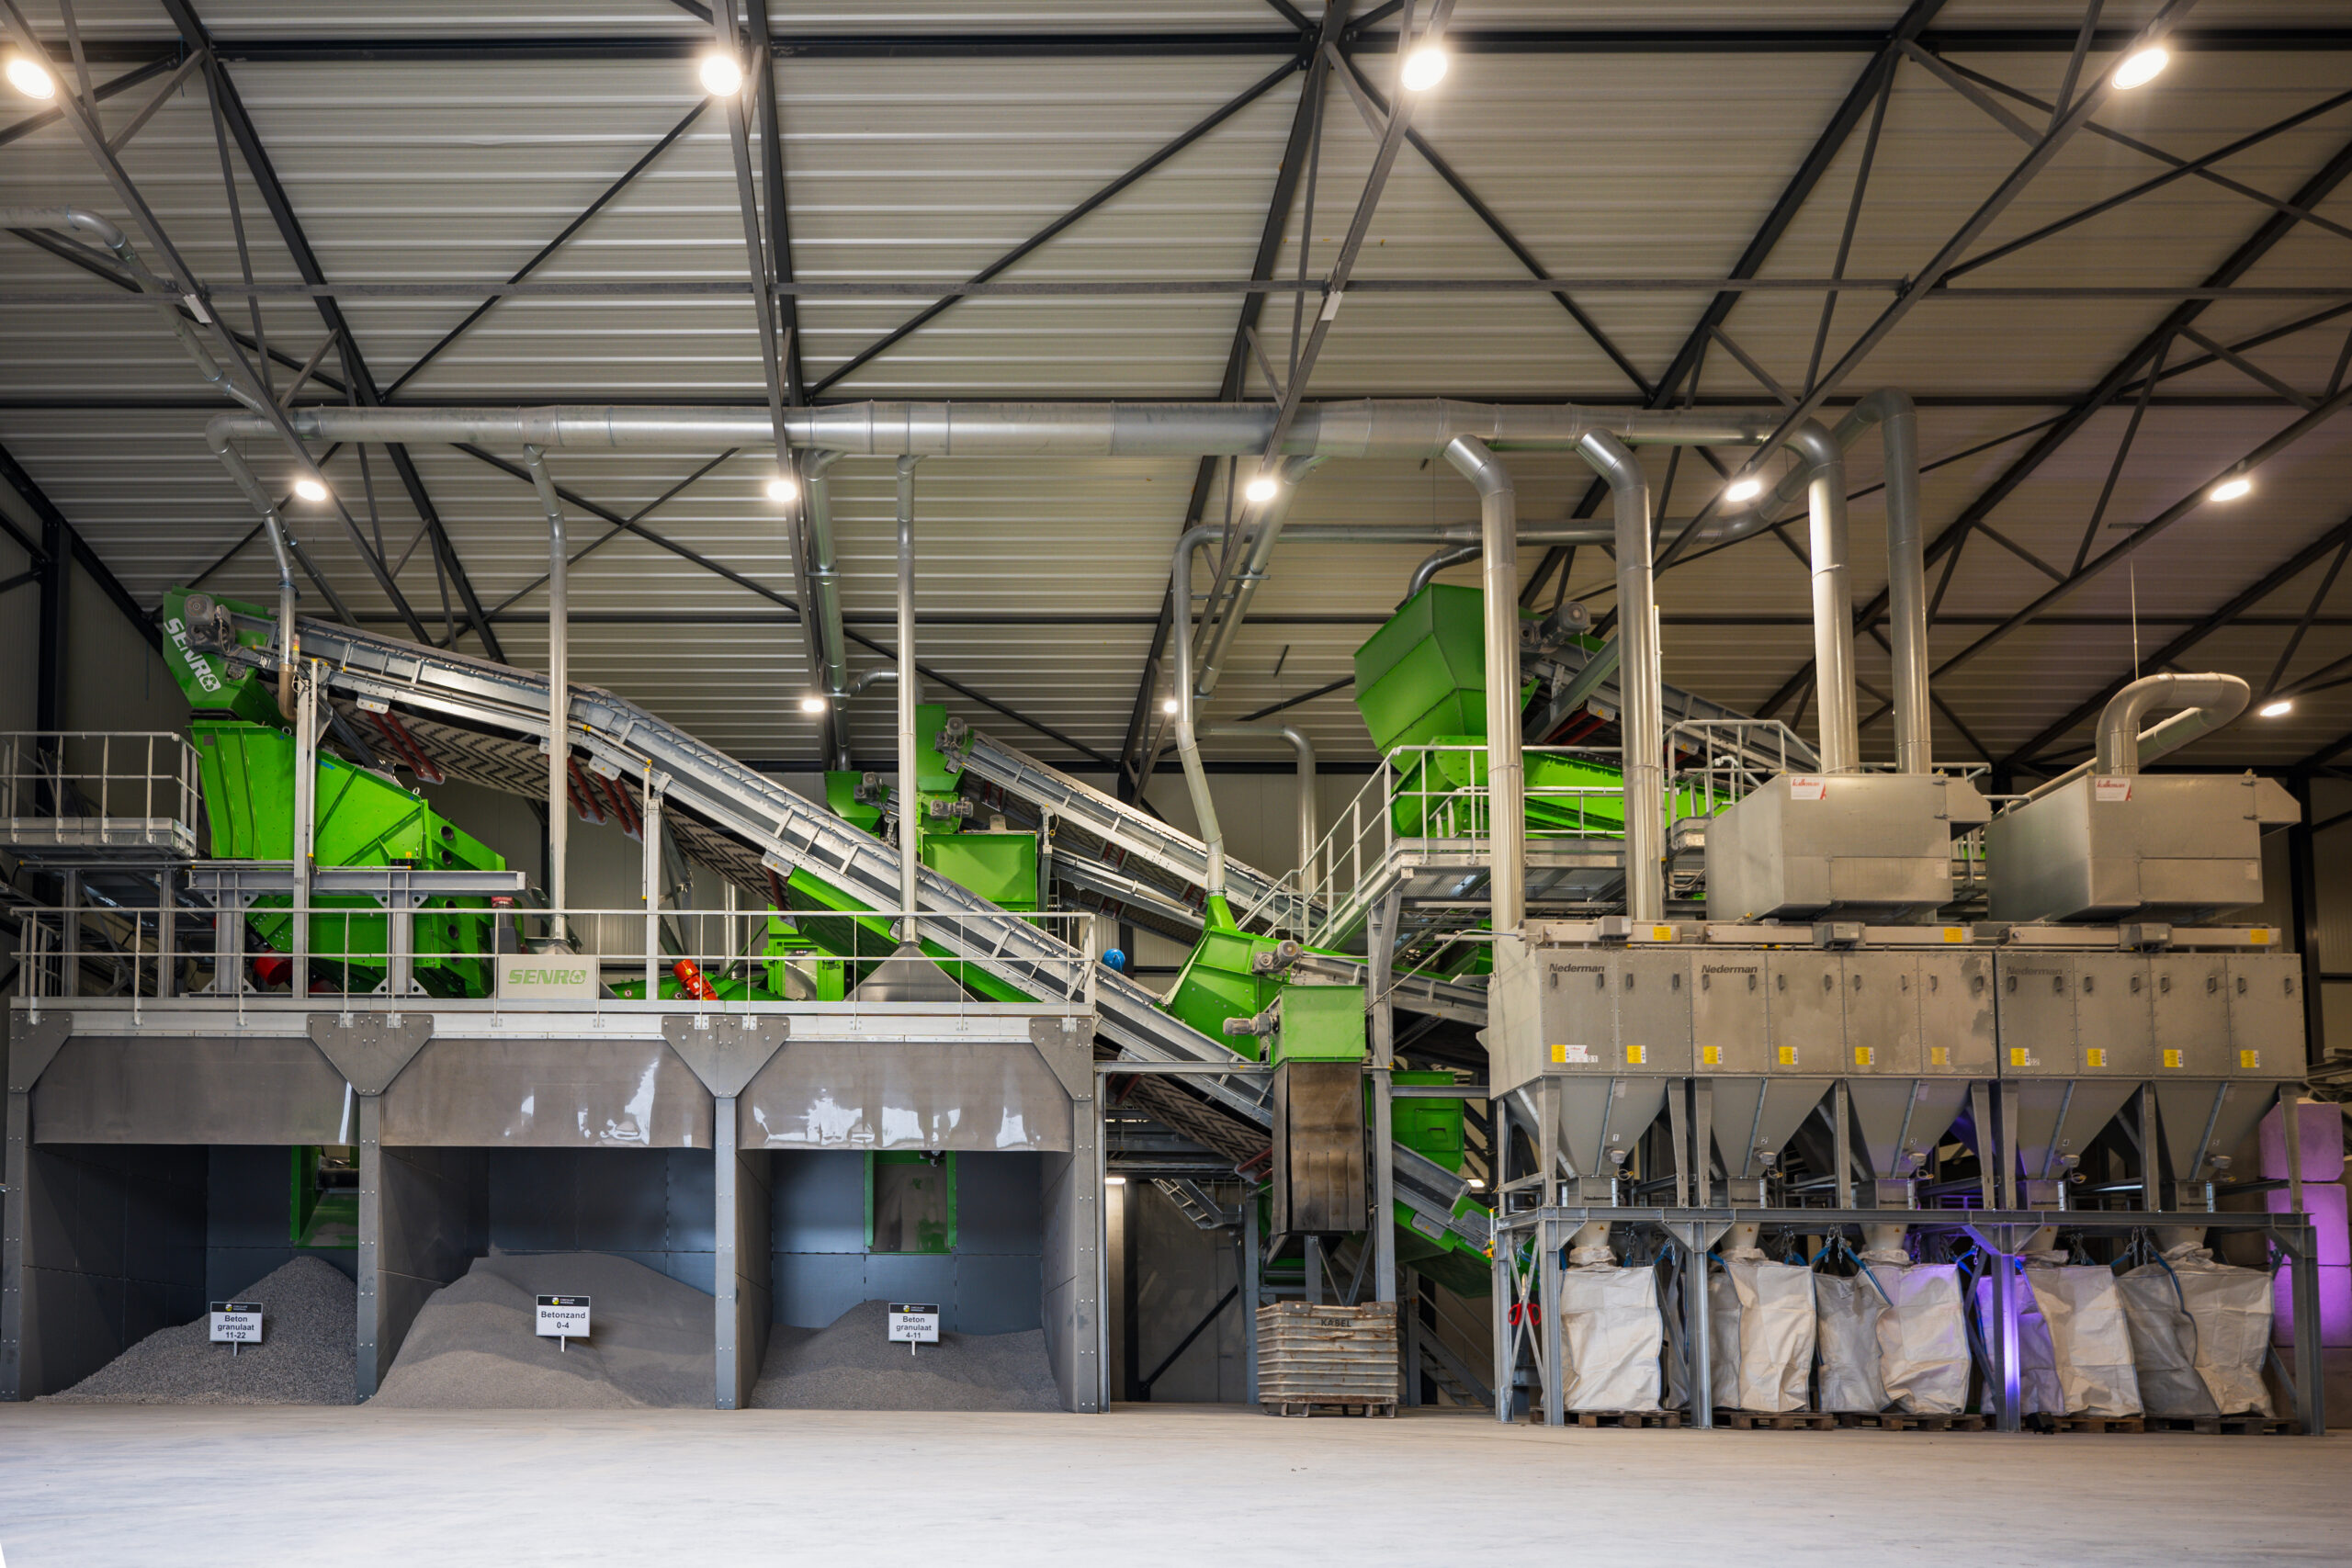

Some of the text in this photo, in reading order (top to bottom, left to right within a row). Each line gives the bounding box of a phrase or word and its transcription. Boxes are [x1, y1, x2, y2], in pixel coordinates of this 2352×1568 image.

[1549, 964, 1605, 973] Nederman
[1702, 964, 1758, 974] Nederman
[508, 969, 587, 985] SENRO
[1320, 1317, 1351, 1327] KABEL
